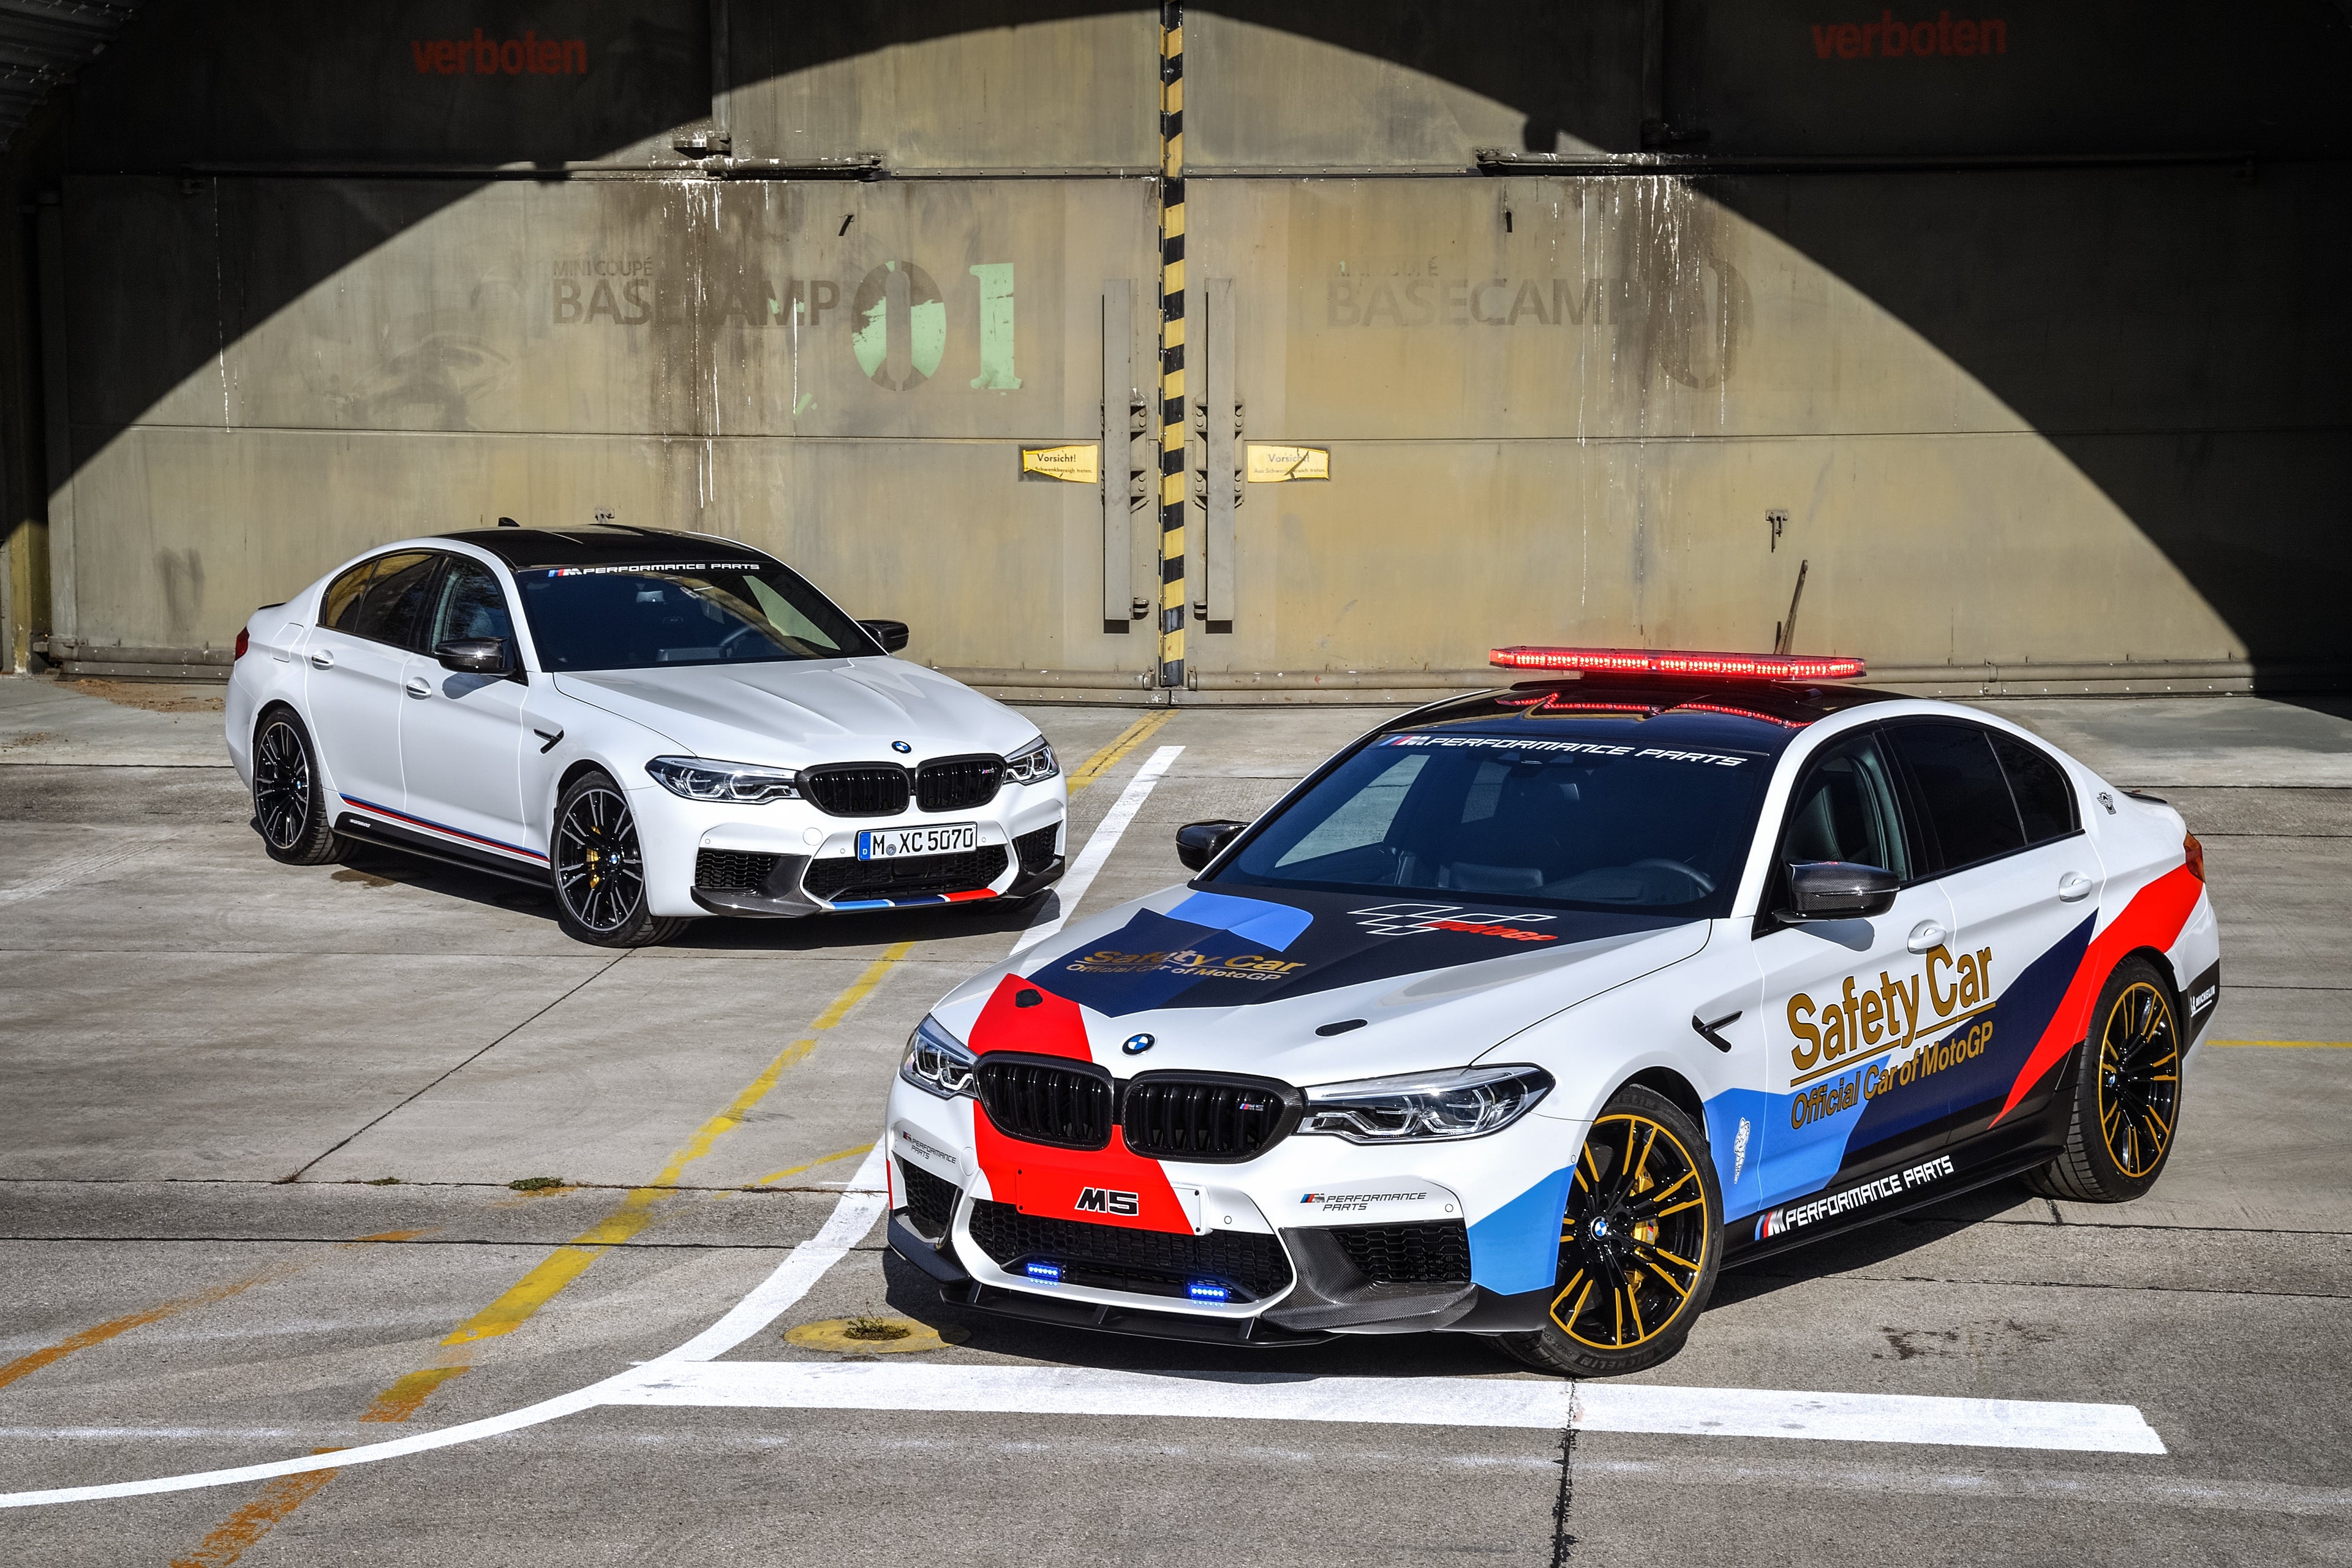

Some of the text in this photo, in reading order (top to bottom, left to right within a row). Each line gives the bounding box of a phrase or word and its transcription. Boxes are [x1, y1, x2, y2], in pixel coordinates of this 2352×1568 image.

[1811, 9, 2007, 59] verboten
[412, 28, 587, 74] verboten
[552, 256, 654, 277] MINI COUPÉ
[552, 260, 1025, 392] BASECAMP 01
[1036, 453, 1076, 462] Vorsicht!
[583, 564, 706, 575] PERFORMANCE
[1423, 737, 1635, 756] PERFORMANCE
[1635, 749, 1748, 767] PARTS
[872, 827, 974, 856] M XC 5070
[1066, 963, 1136, 973] Official
[1171, 967, 1194, 976] of
[1193, 968, 1282, 981] MotoGP
[1083, 949, 1307, 972] Safety Car
[1785, 943, 1991, 1071] Safety Car
[1790, 1020, 1994, 1131] Official Car of MotoGP
[911, 1145, 930, 1159] PARTS
[912, 1138, 957, 1164] PERFORMANCE
[1074, 1186, 1139, 1216] M5
[1325, 1192, 1427, 1203] PERFORMANCE
[1785, 1174, 1903, 1230] PERFORMANCE
[1902, 1155, 1954, 1189] PARTS
[1322, 1203, 1368, 1212] PARTS
